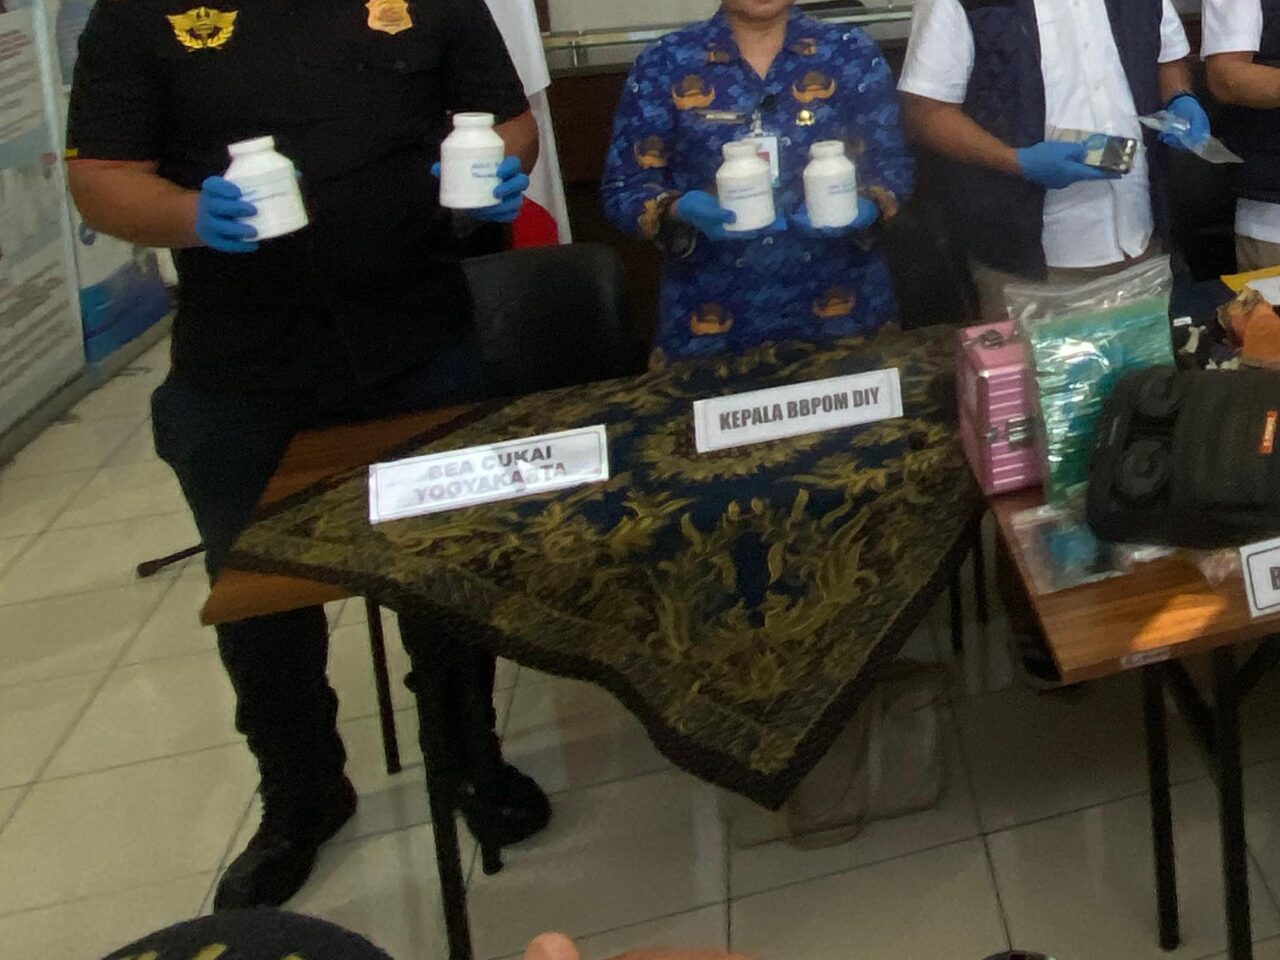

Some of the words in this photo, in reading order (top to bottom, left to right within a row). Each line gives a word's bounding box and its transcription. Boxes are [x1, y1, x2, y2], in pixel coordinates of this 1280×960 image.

[719, 403, 783, 431] KEPALA
[787, 392, 848, 419] BBPOM
[852, 386, 880, 408] DIY
[428, 459, 474, 480] BEA
[481, 445, 552, 471] CUKAI
